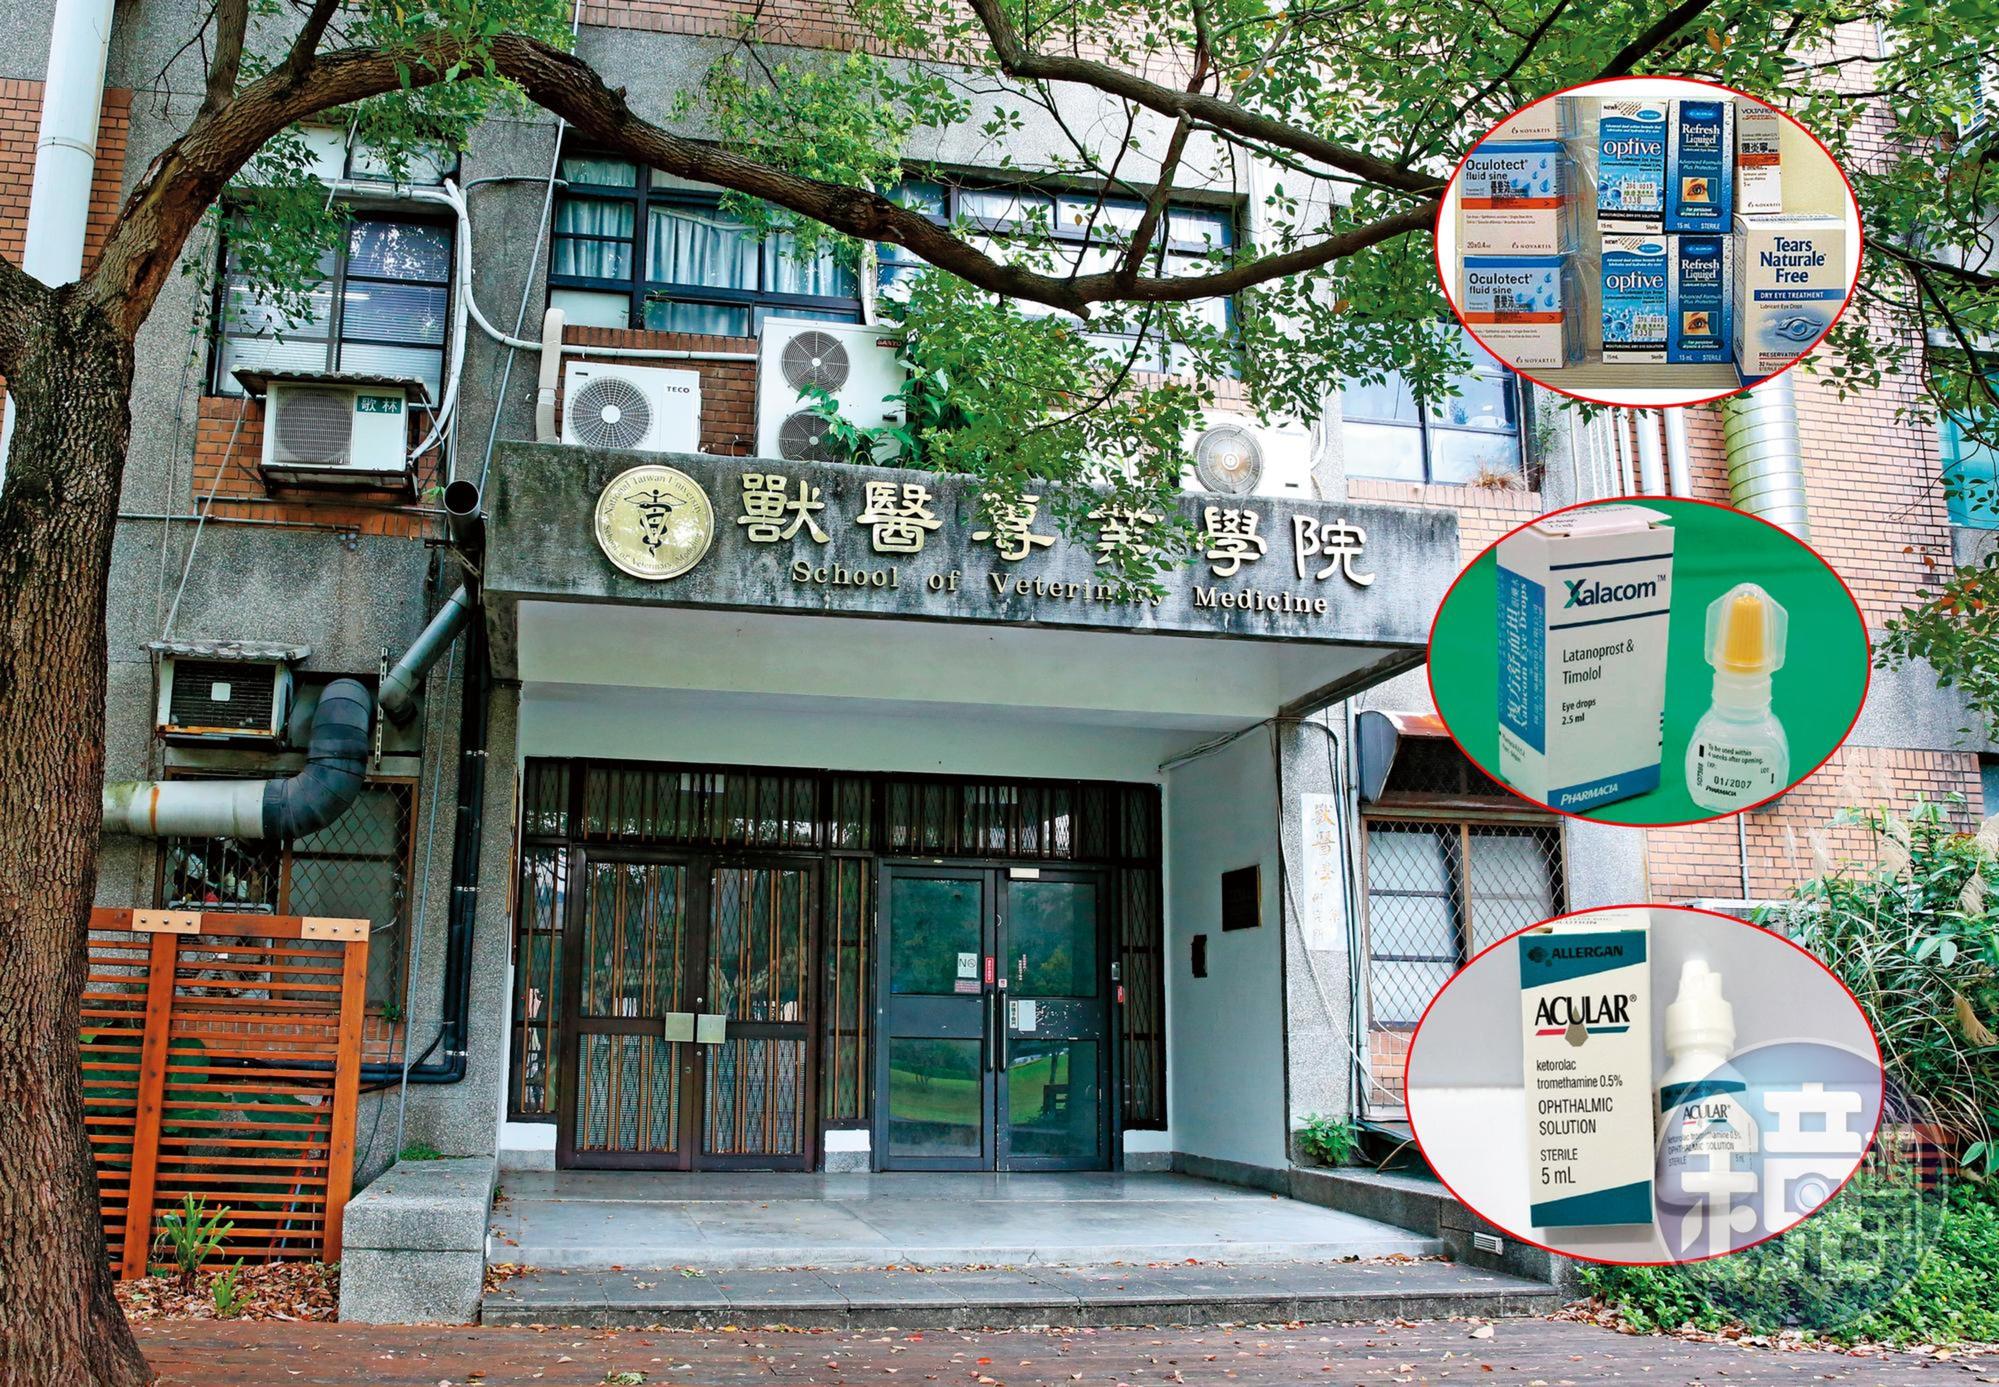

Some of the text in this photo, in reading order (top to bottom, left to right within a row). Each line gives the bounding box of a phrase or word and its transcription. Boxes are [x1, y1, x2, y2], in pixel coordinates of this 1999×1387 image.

[1682, 123, 1720, 134] Refresh
[1685, 134, 1716, 147] Liquigel
[1603, 138, 1661, 160] optive
[1466, 171, 1508, 180] fluid sine
[1773, 237, 1812, 252] Tears
[1682, 259, 1720, 270] Refresh
[1606, 270, 1664, 293] optive
[1685, 270, 1716, 281] Liquigel
[1775, 268, 1809, 283] Free
[1469, 286, 1512, 294] fluid sine
[1774, 291, 1786, 299] EYE
[667, 386, 690, 394] TECO
[361, 397, 398, 413] 歌林
[633, 475, 665, 485] Taiwan
[792, 560, 900, 588] School
[929, 570, 960, 591] of
[1194, 586, 1328, 614] Medicine
[1519, 582, 1528, 630] Drops
[1562, 638, 1634, 663] Latanoprost &
[1562, 665, 1602, 685] Timolol
[1562, 698, 1596, 712] Eye drops
[1561, 713, 1585, 725] 2.5 ml
[1712, 753, 1727, 761] weeks
[1728, 755, 1741, 763] after
[1722, 747, 1734, 755] used
[1735, 748, 1752, 756] within
[1713, 776, 1752, 789] 01/2007
[1560, 783, 1619, 806] PHARMACIA
[1705, 785, 1737, 797] PHARMACIA
[1551, 945, 1624, 959] ALLERGAN
[1536, 1059, 1576, 1071] ketorolac
[1537, 1074, 1623, 1089] tromethamine 0.5%
[1538, 1097, 1613, 1115] OPHTHALMIC
[1539, 1119, 1597, 1136] SOLUTION
[1540, 1148, 1578, 1162] STERILE
[1541, 1166, 1576, 1185] 5 mL
